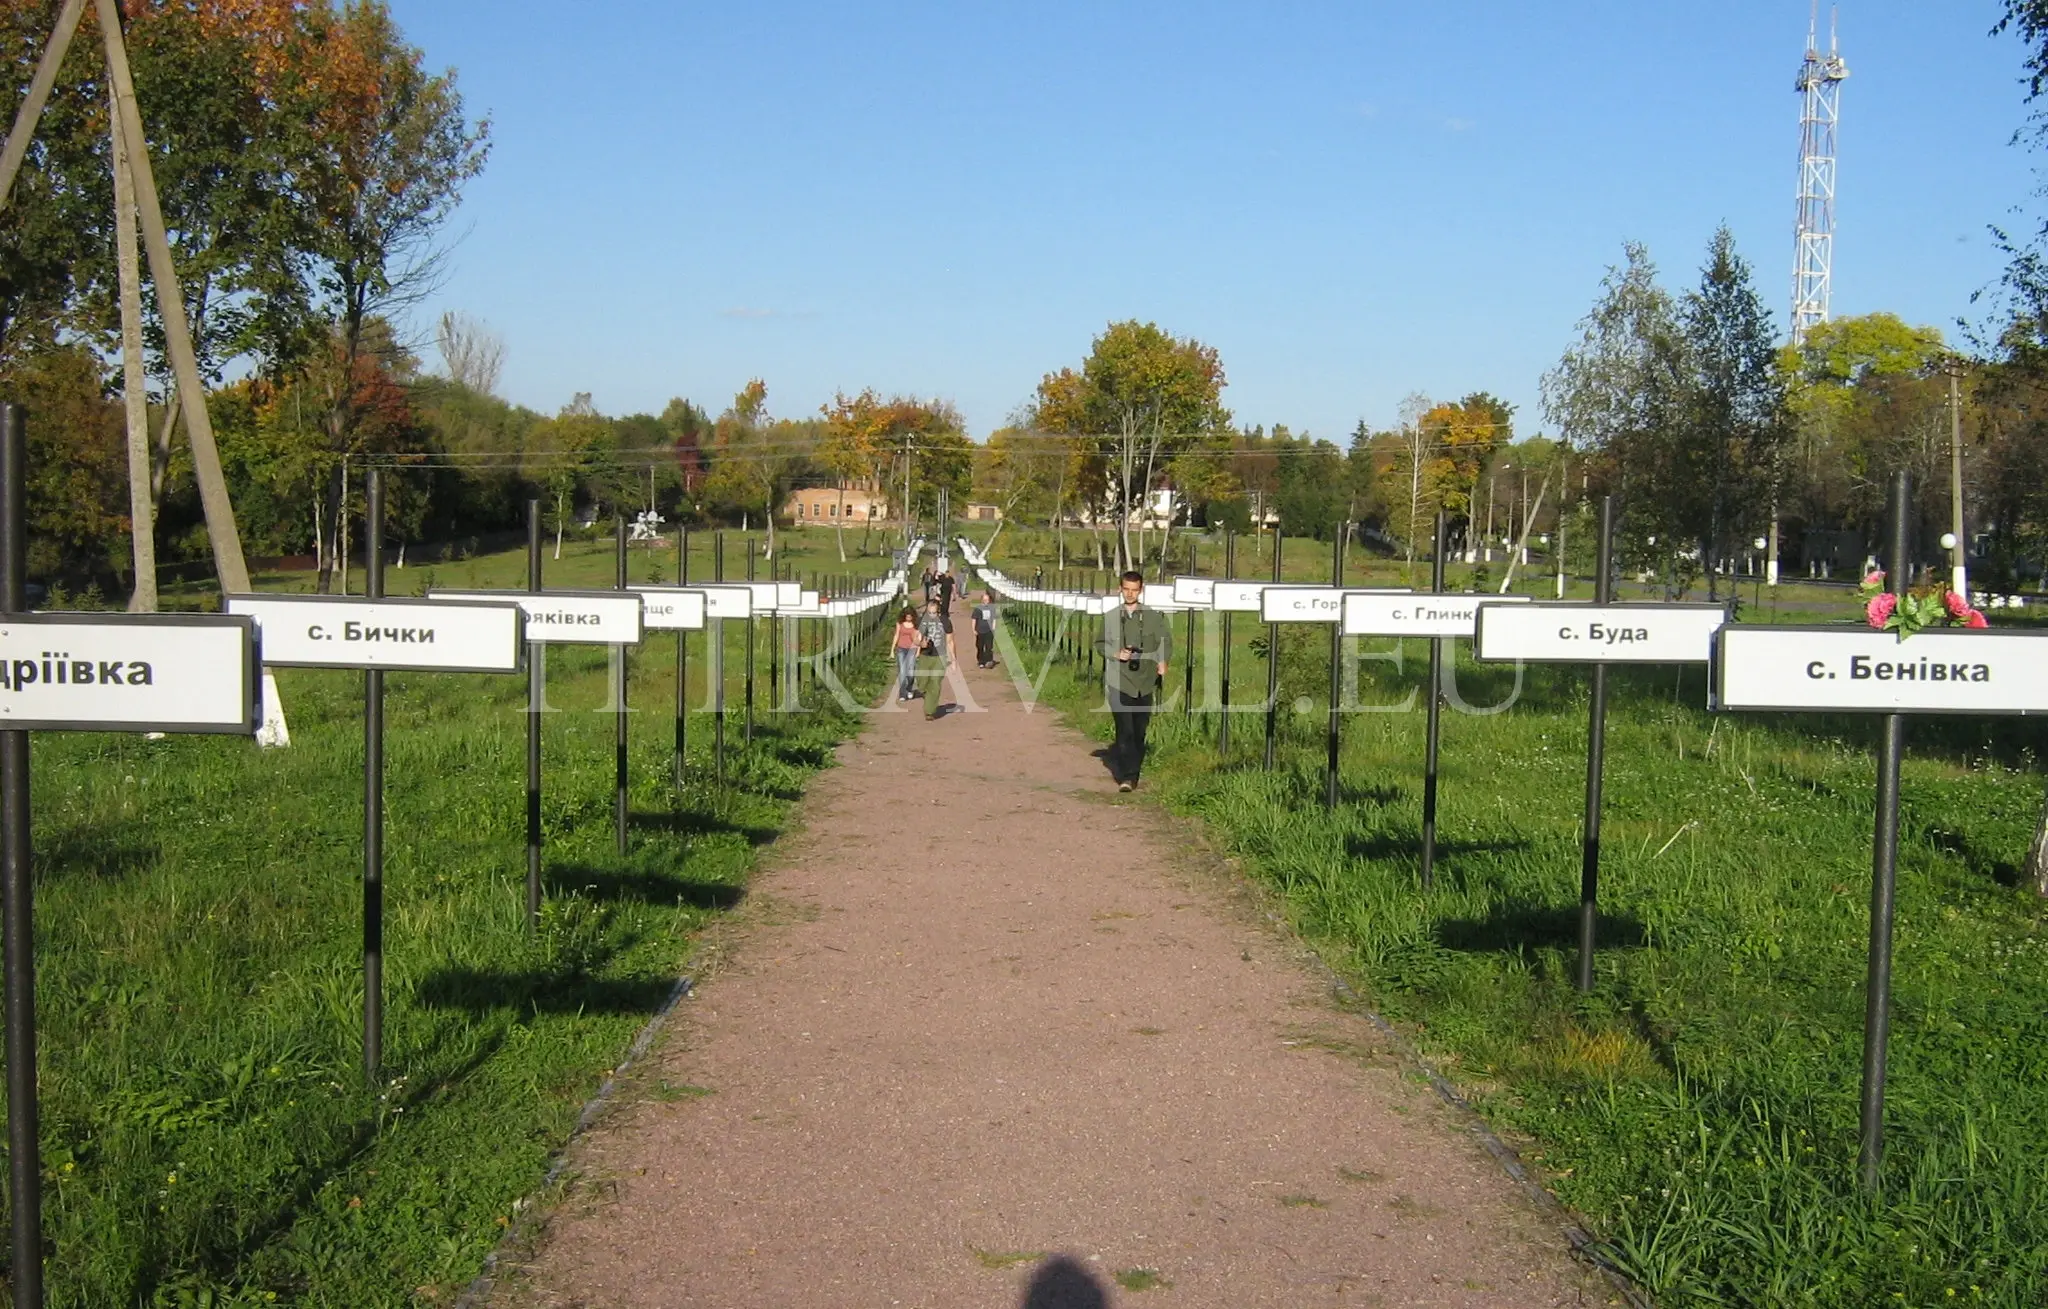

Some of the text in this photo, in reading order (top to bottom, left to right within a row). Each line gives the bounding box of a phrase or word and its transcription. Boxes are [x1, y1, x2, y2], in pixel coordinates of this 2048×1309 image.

[1392, 610, 1407, 620] с.
[307, 621, 435, 643] с. Бички
[1558, 623, 1649, 645] с. Буда
[1806, 655, 1990, 682] с. Бенівка
